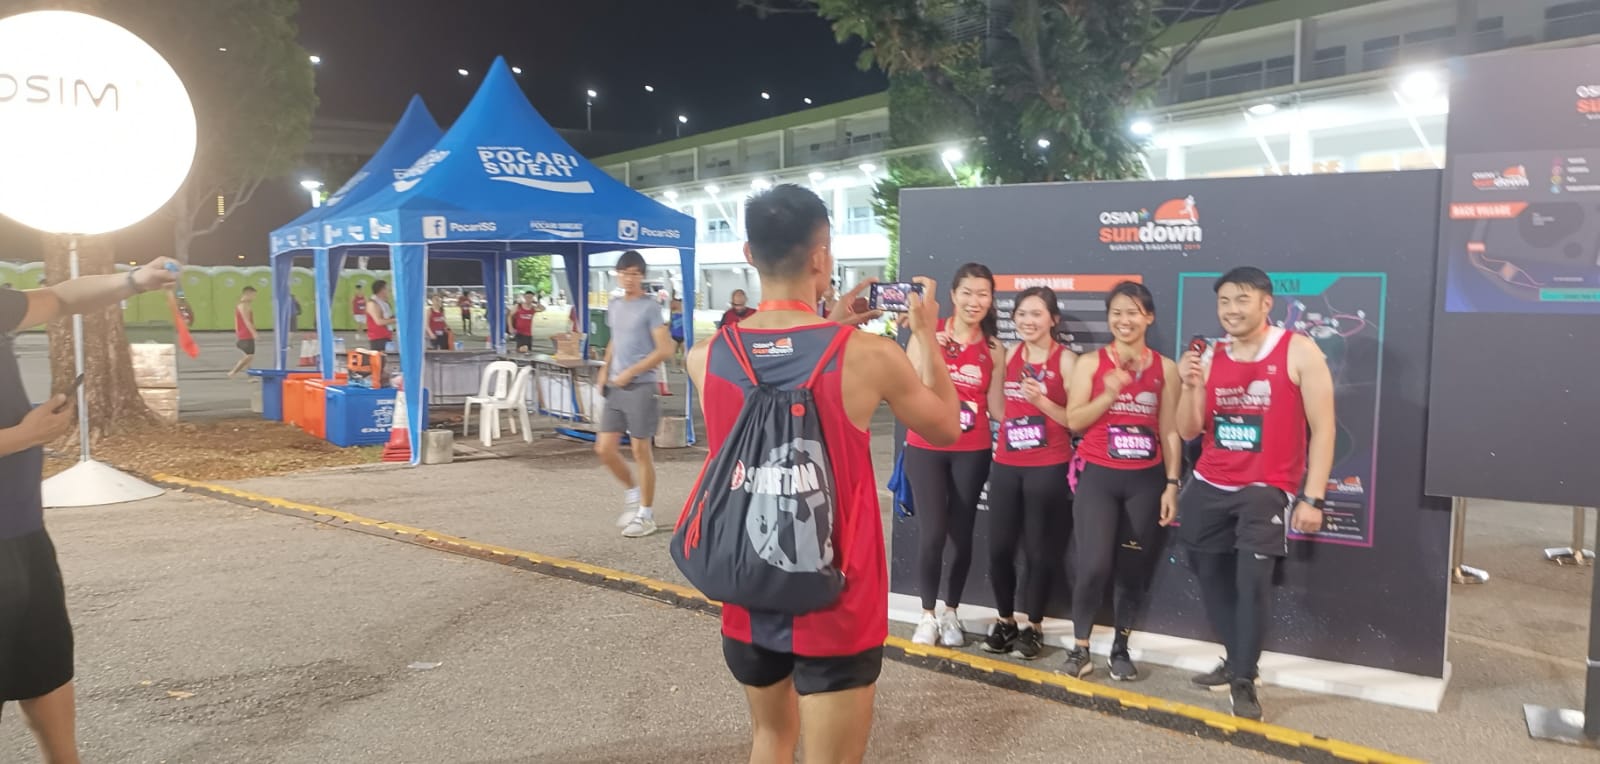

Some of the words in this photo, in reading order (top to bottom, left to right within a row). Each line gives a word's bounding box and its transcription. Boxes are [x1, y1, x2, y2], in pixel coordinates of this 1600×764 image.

[477, 150, 579, 168] POCARI
[484, 162, 573, 177] SWEAT
[1476, 205, 1511, 216] VILLAGE
[1099, 211, 1139, 224] OSIM
[449, 222, 497, 232] PocariSG
[640, 226, 681, 239] PocariSG
[1099, 222, 1202, 243] sundown
[1014, 277, 1075, 290] PROGRAMME
